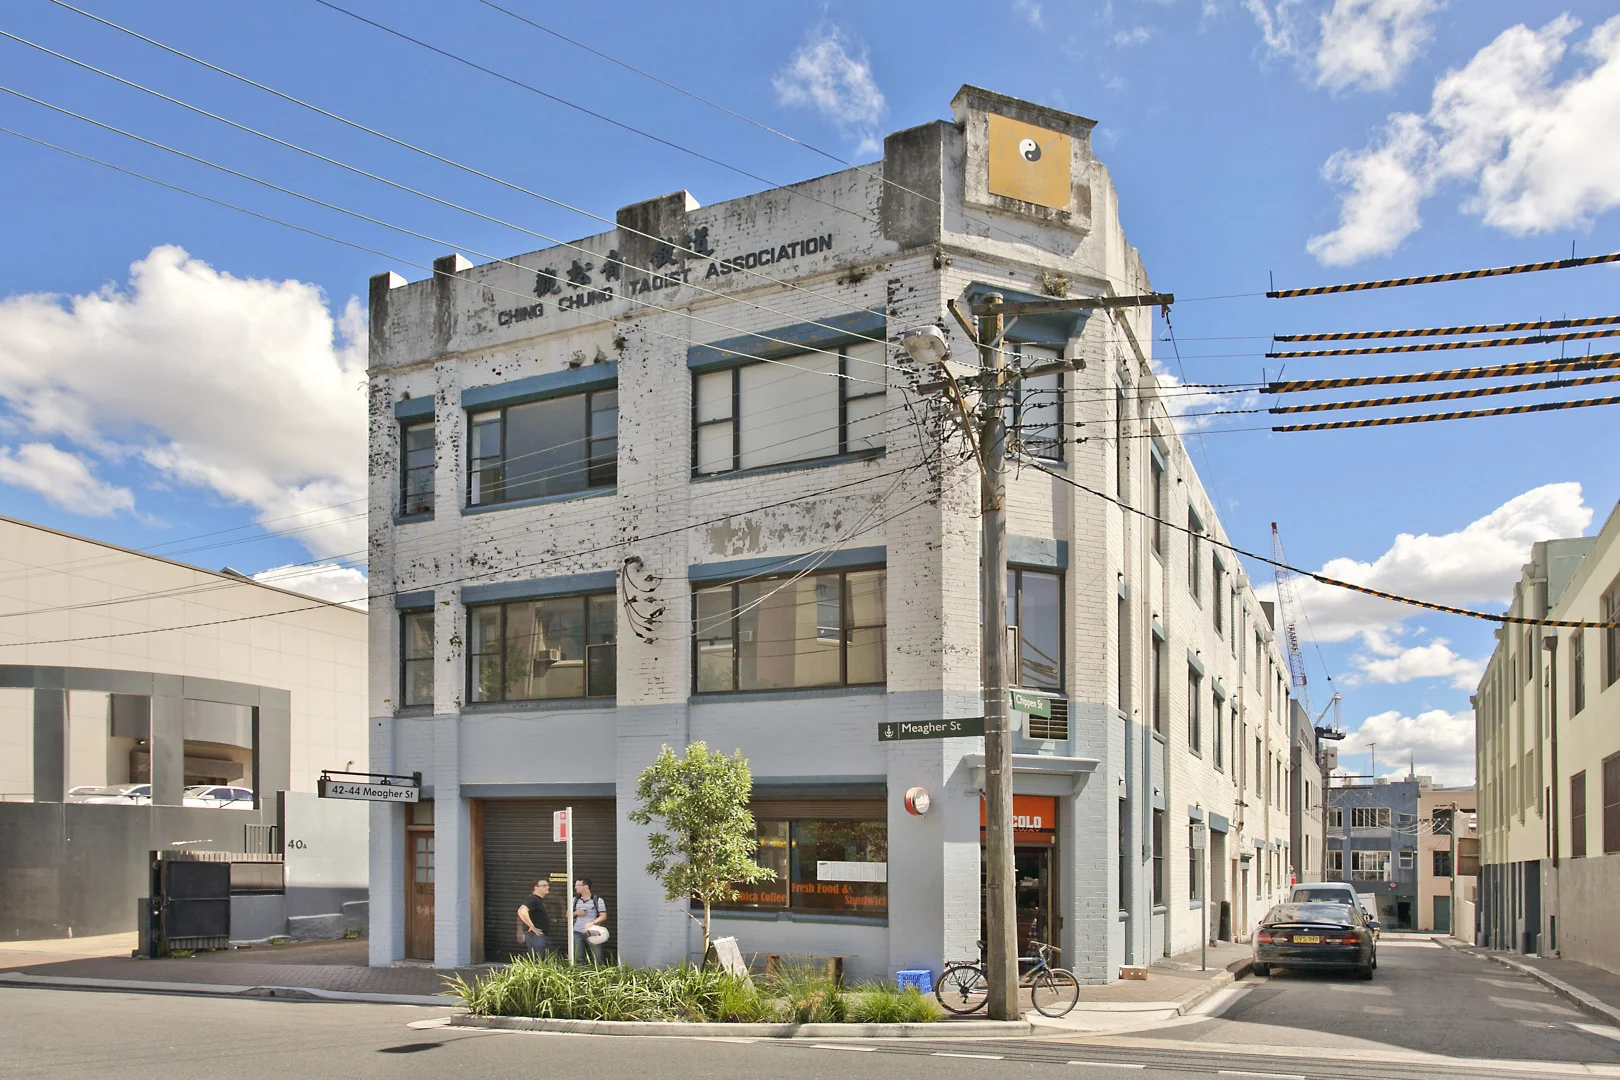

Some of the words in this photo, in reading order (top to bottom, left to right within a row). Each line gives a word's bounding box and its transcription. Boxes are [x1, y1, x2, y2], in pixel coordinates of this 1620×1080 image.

[497, 302, 544, 326] CHING
[558, 286, 613, 312] CHUNG
[629, 267, 692, 295] TAOIST
[705, 233, 833, 279] ASSOCIATION
[1015, 694, 1037, 709] Chippen
[1037, 699, 1044, 710] St
[901, 722, 947, 735] Meagher
[950, 721, 961, 731] St
[332, 785, 361, 795] 42-44
[363, 786, 403, 799] Meagher
[405, 790, 413, 799] St
[791, 882, 815, 893] Fresh
[817, 883, 839, 894] Food
[841, 883, 850, 894] &
[760, 891, 787, 902] Coffee
